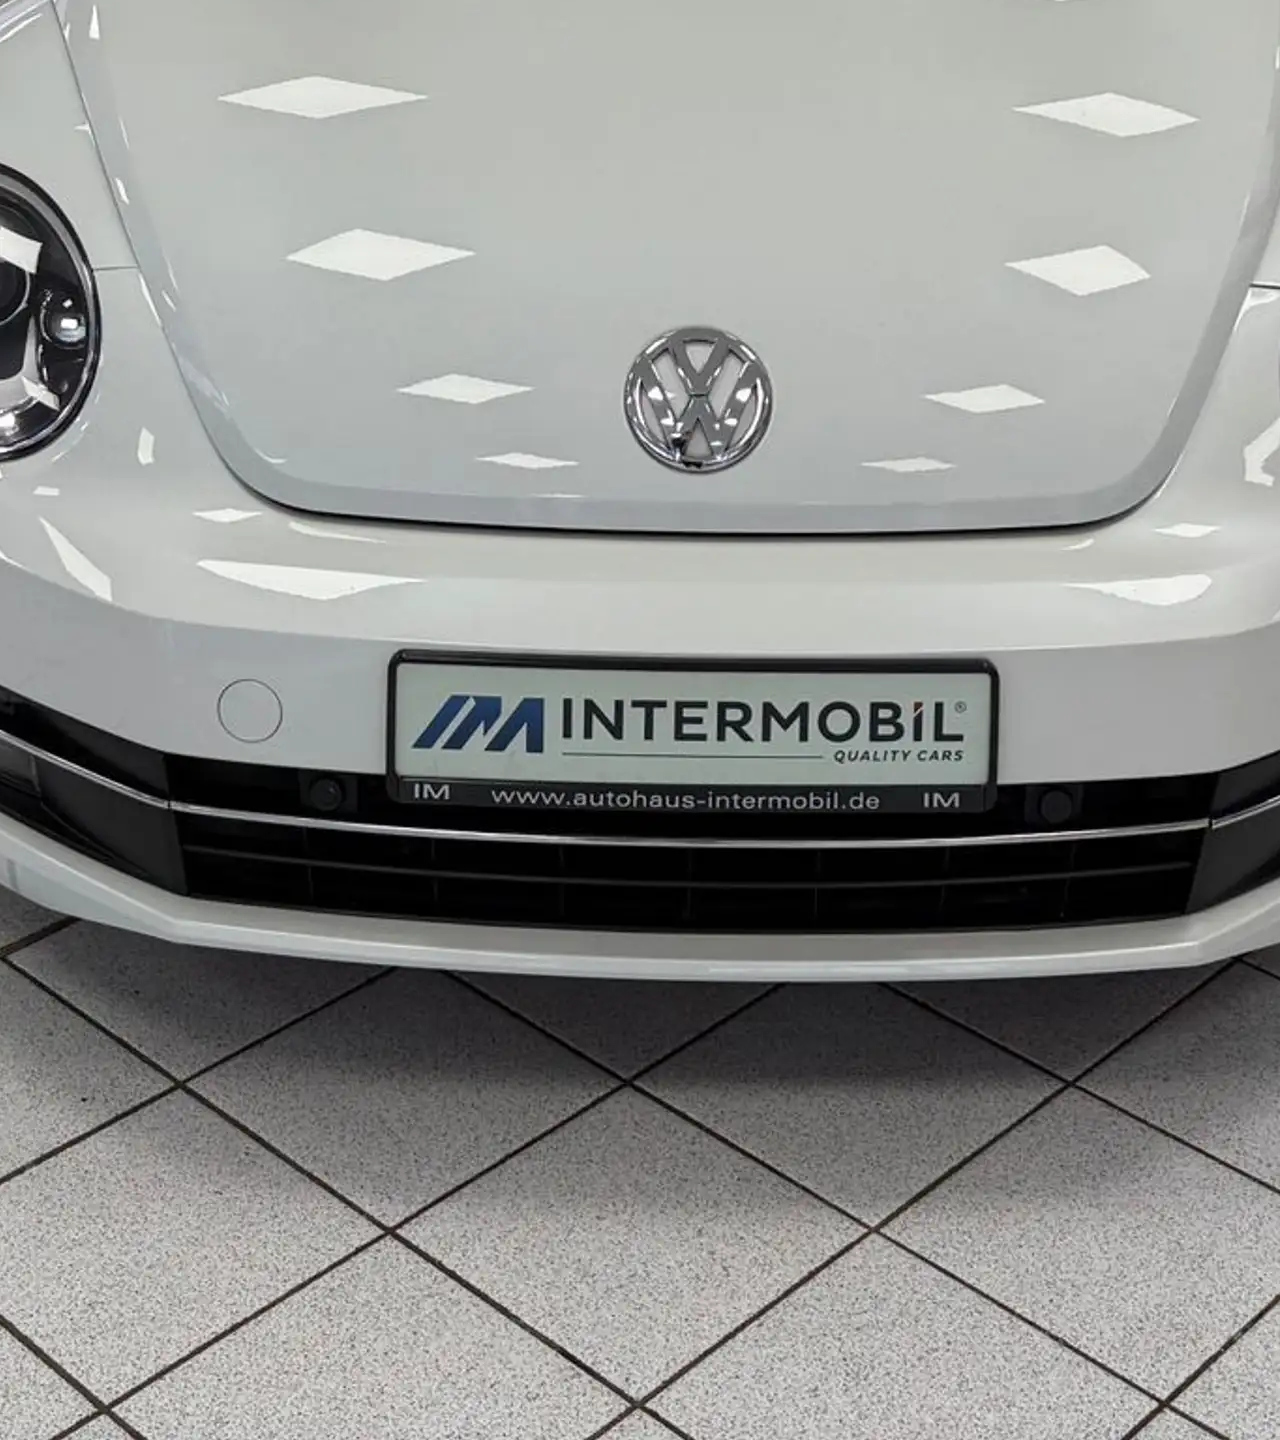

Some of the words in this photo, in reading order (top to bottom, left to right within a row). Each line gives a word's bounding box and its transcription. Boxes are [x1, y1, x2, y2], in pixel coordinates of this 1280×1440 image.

[833, 750, 912, 764] QUALITY
[916, 750, 964, 762] CARS
[414, 783, 450, 800] IM
[491, 789, 880, 810] www.autohaus-intermobil.de
[923, 791, 960, 809] IM
